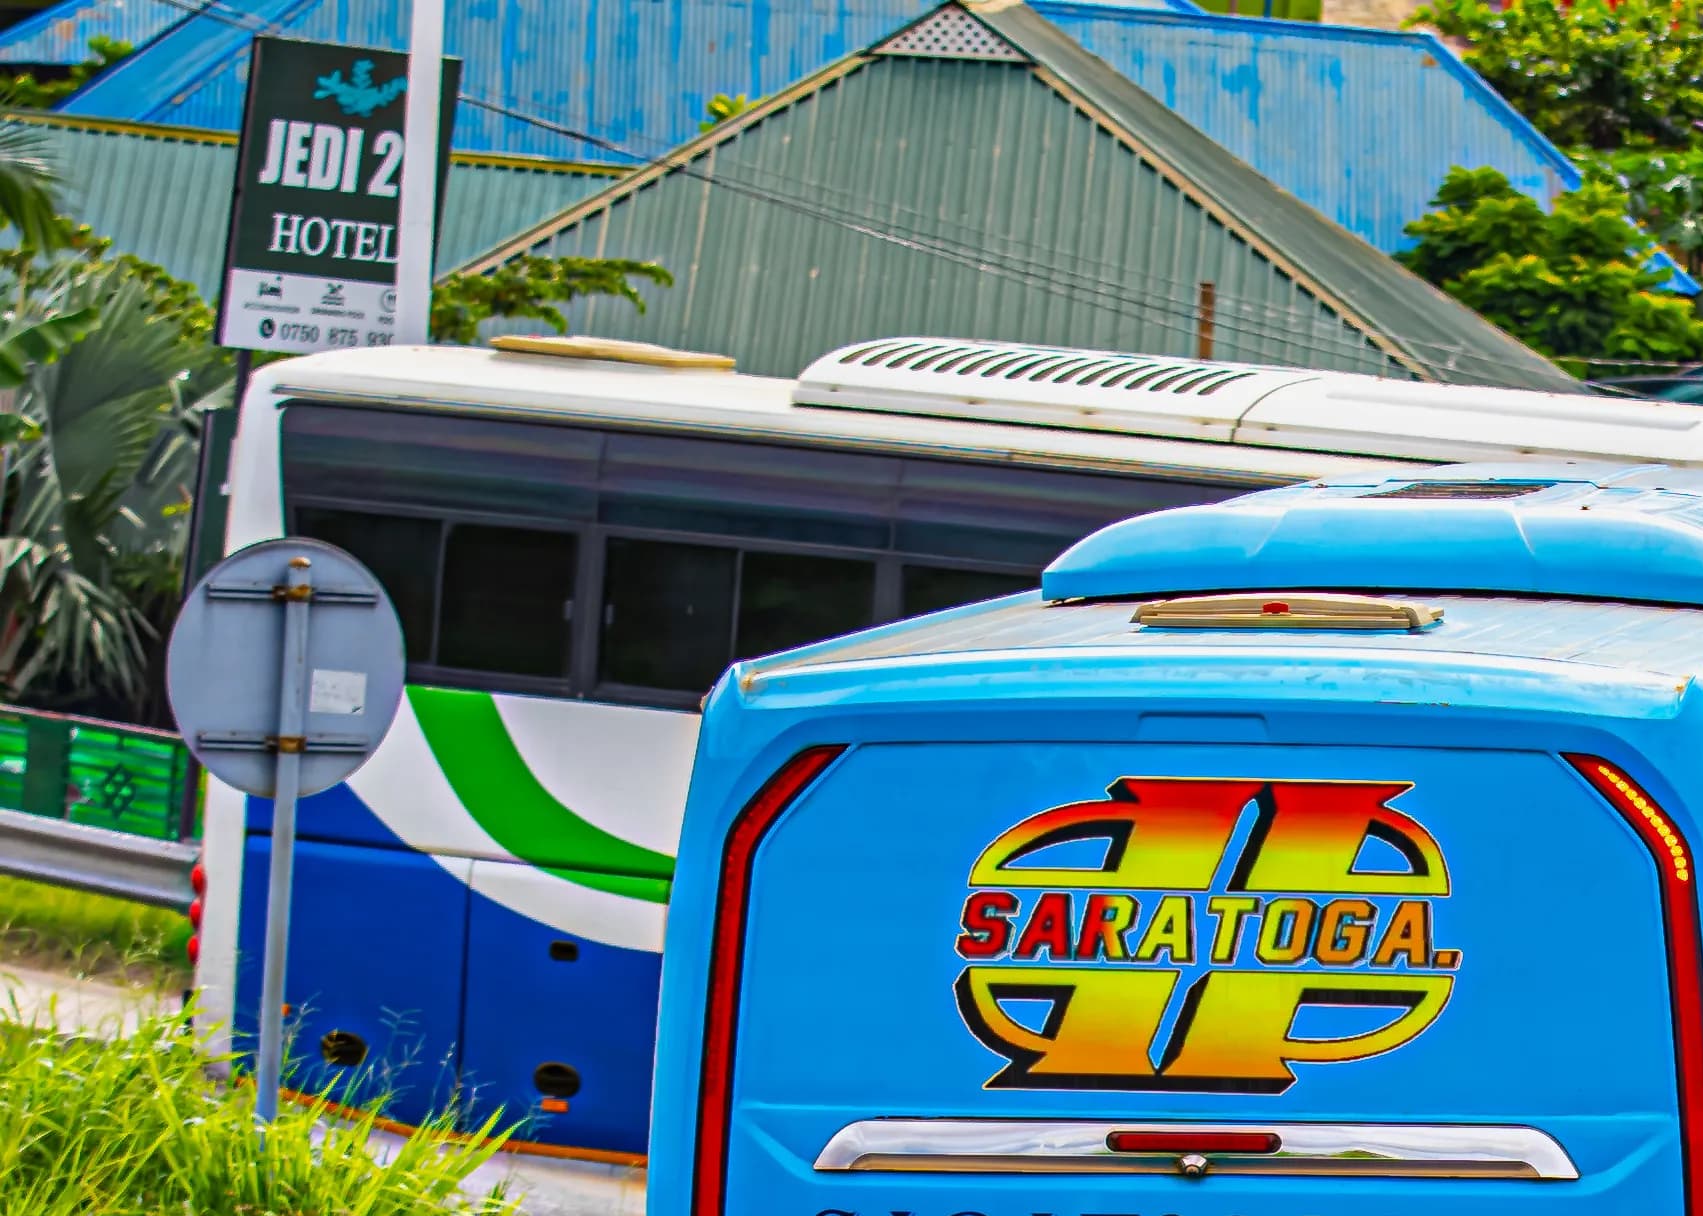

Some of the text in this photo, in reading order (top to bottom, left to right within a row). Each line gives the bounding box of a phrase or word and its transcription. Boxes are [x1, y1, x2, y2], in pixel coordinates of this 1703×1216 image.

[258, 118, 405, 198] JEDI 2
[267, 212, 401, 264] HOTEL
[280, 322, 320, 343] 0750
[327, 327, 359, 347] 875
